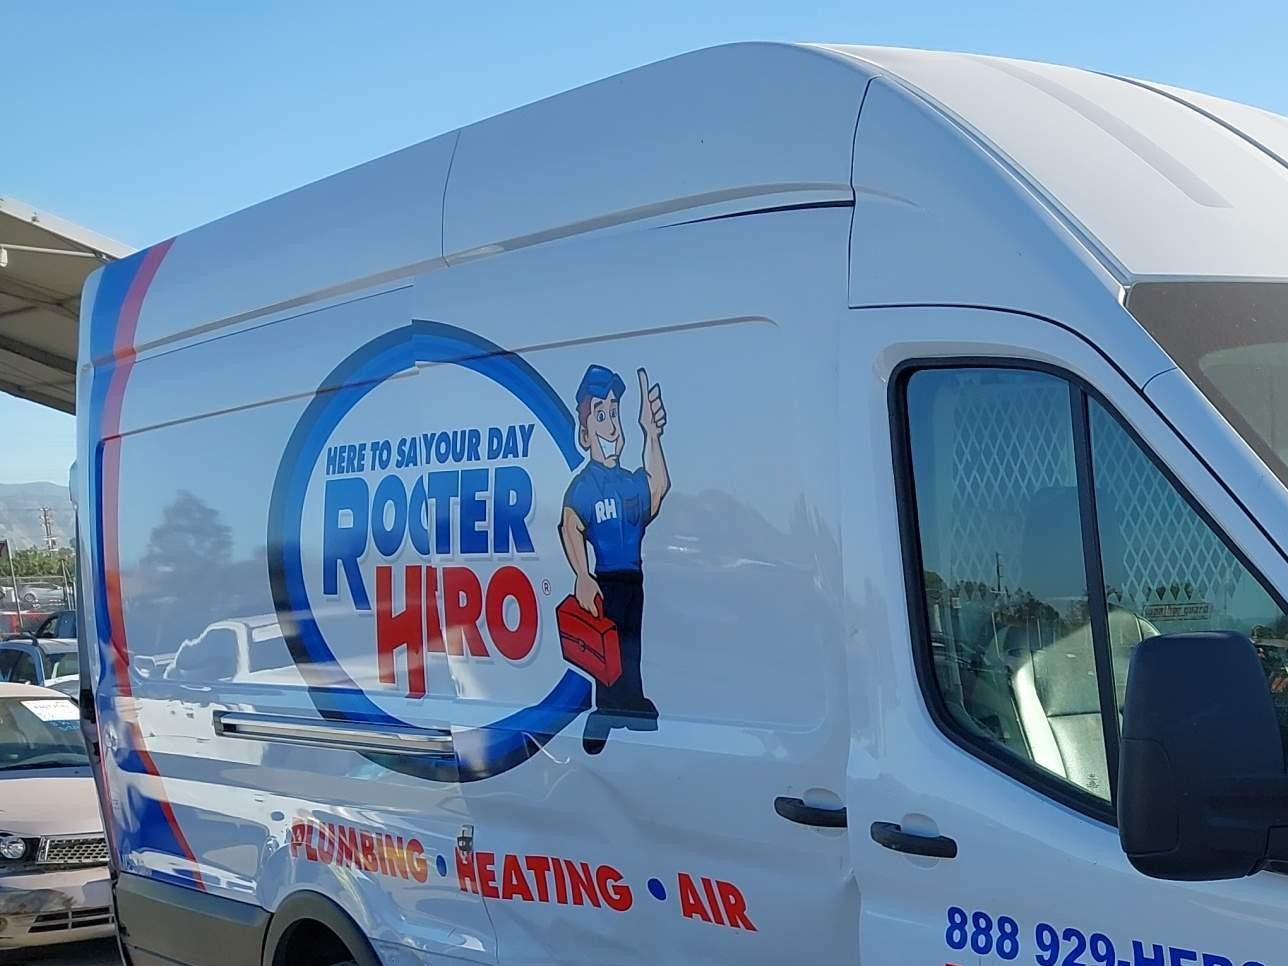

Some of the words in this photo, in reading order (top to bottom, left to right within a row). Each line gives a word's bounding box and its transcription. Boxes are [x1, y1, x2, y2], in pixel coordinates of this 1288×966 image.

[326, 443, 367, 475] HERE
[371, 440, 391, 471] TO
[422, 429, 481, 465] YOUR
[487, 424, 535, 460] DAY
[595, 498, 617, 523] RH
[290, 822, 429, 883] PLUMBING
[455, 848, 633, 912] HEATING
[677, 872, 758, 932] AIR
[945, 906, 1019, 960] 888
